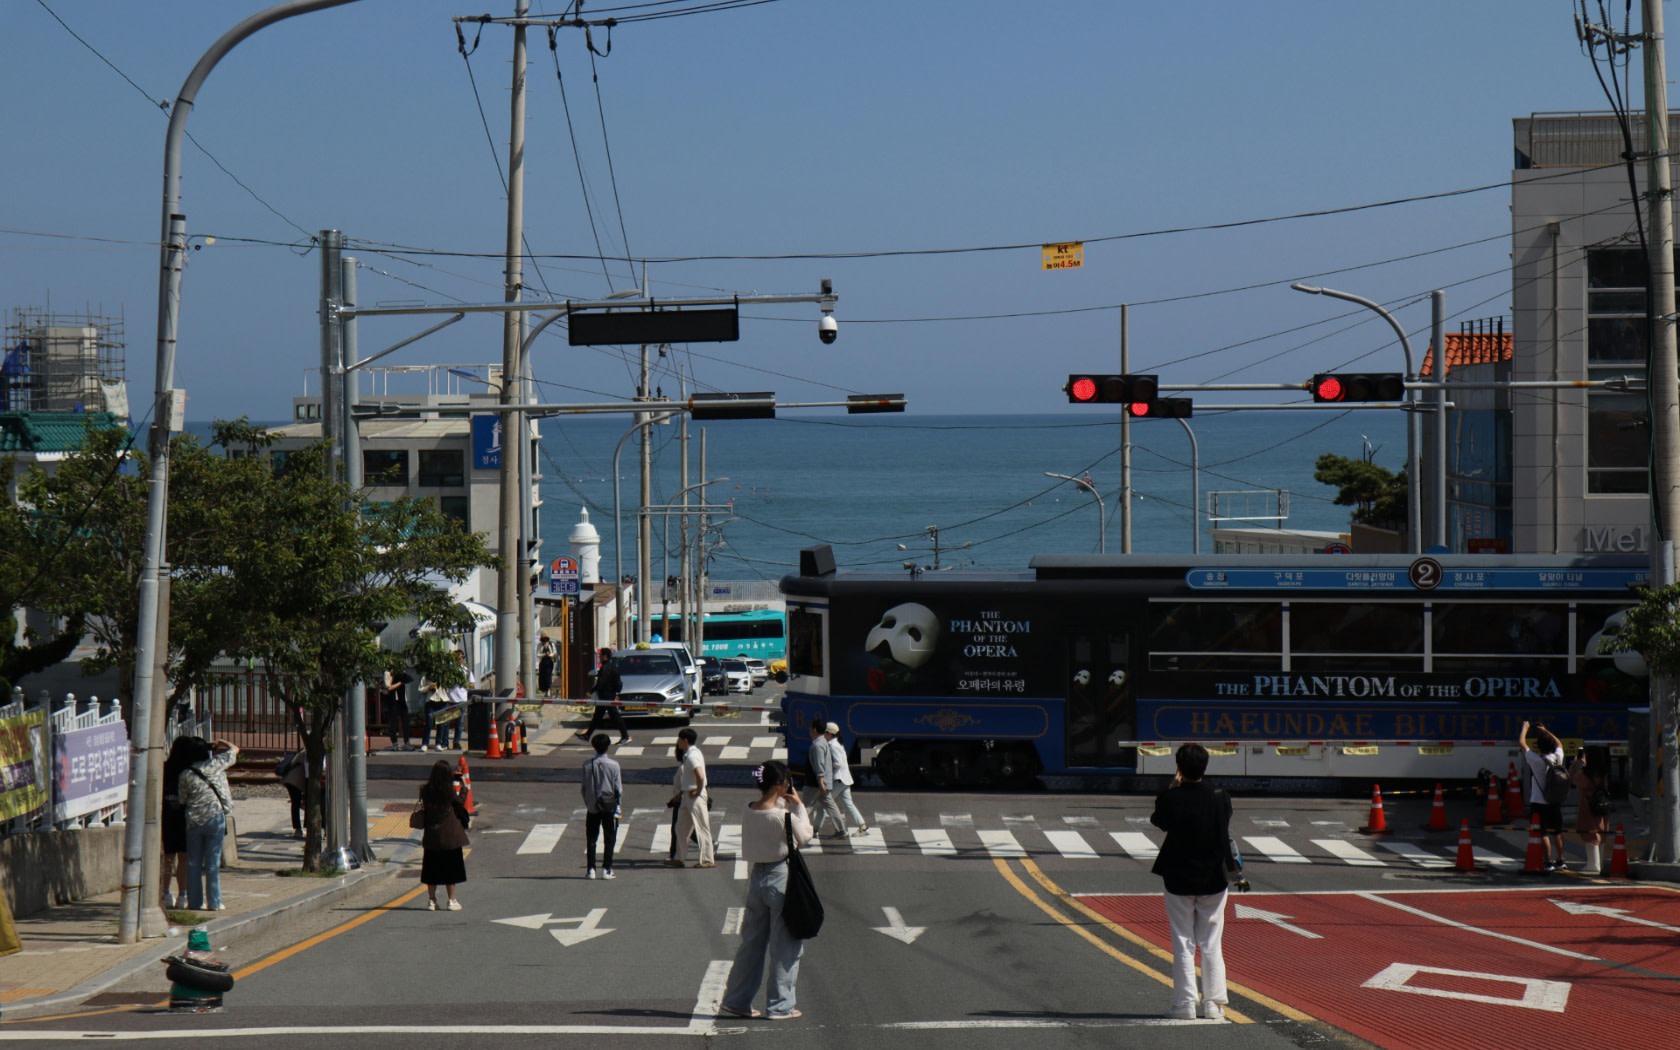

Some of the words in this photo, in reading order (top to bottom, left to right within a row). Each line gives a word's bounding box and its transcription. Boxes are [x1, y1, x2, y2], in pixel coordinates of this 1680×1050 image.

[482, 455, 501, 465] 청사
[1417, 563, 1435, 584] 2
[980, 611, 1001, 619] THE
[950, 620, 1031, 633] PHANTOM
[974, 635, 986, 643] OF
[989, 635, 1008, 643] THE
[964, 644, 1018, 657] OPERA
[957, 679, 1001, 691] 오페라의
[1003, 679, 1025, 692] 유령
[1215, 683, 1249, 695] THE
[1253, 675, 1397, 697] PHANTOM
[1401, 685, 1423, 697] OF
[1427, 685, 1461, 697] THE
[1464, 677, 1562, 698] OPERA
[1191, 711, 1376, 736] HAEUNDAE
[71, 755, 87, 783] 도로
[87, 750, 102, 783] 무단
